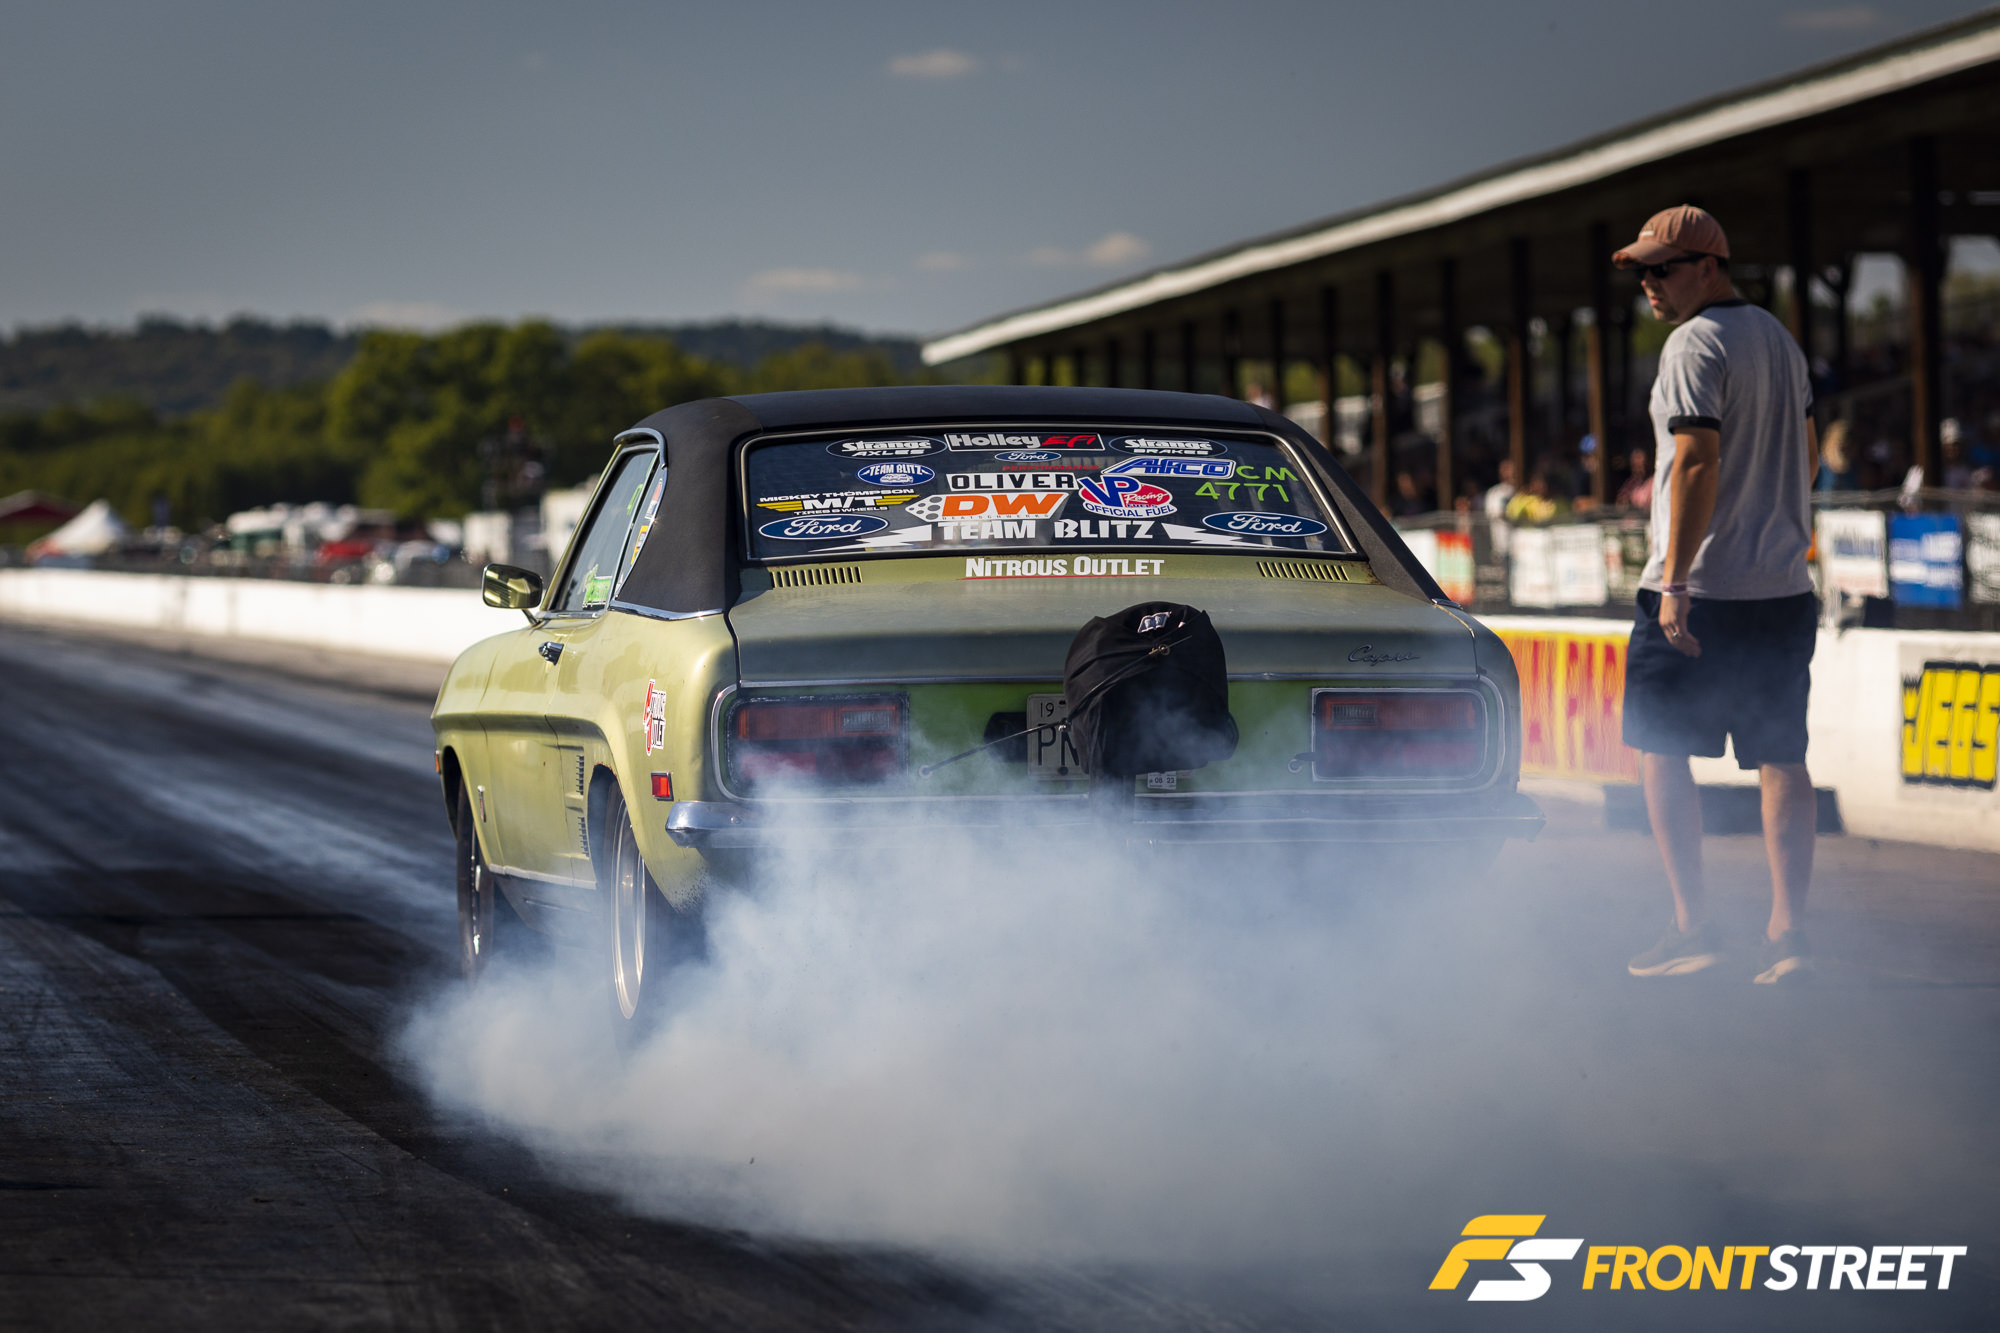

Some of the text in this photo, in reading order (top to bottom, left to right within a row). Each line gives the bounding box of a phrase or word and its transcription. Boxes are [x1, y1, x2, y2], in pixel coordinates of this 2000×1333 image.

[842, 440, 932, 452] Strange
[948, 434, 1097, 448] Holley EFI
[1125, 438, 1213, 450] Strange
[852, 449, 925, 457] AXLES
[1007, 452, 1049, 460] Ford
[869, 464, 923, 477] TEAM BLITZ
[1108, 457, 1231, 476] AFCO
[1235, 465, 1299, 482] CM
[951, 474, 1075, 489] OLIVER
[759, 488, 915, 502] MICKEY THOMPSON
[1078, 476, 1140, 507] VP
[1123, 492, 1169, 504] Racing
[1195, 481, 1290, 502] 4771
[803, 496, 883, 510] M/T
[942, 494, 1065, 517] DW
[1085, 503, 1175, 517] OFFICIAL FUEL
[783, 517, 862, 536] Ford
[938, 518, 1154, 540] TEAM BLITZ
[1227, 513, 1302, 533] Ford
